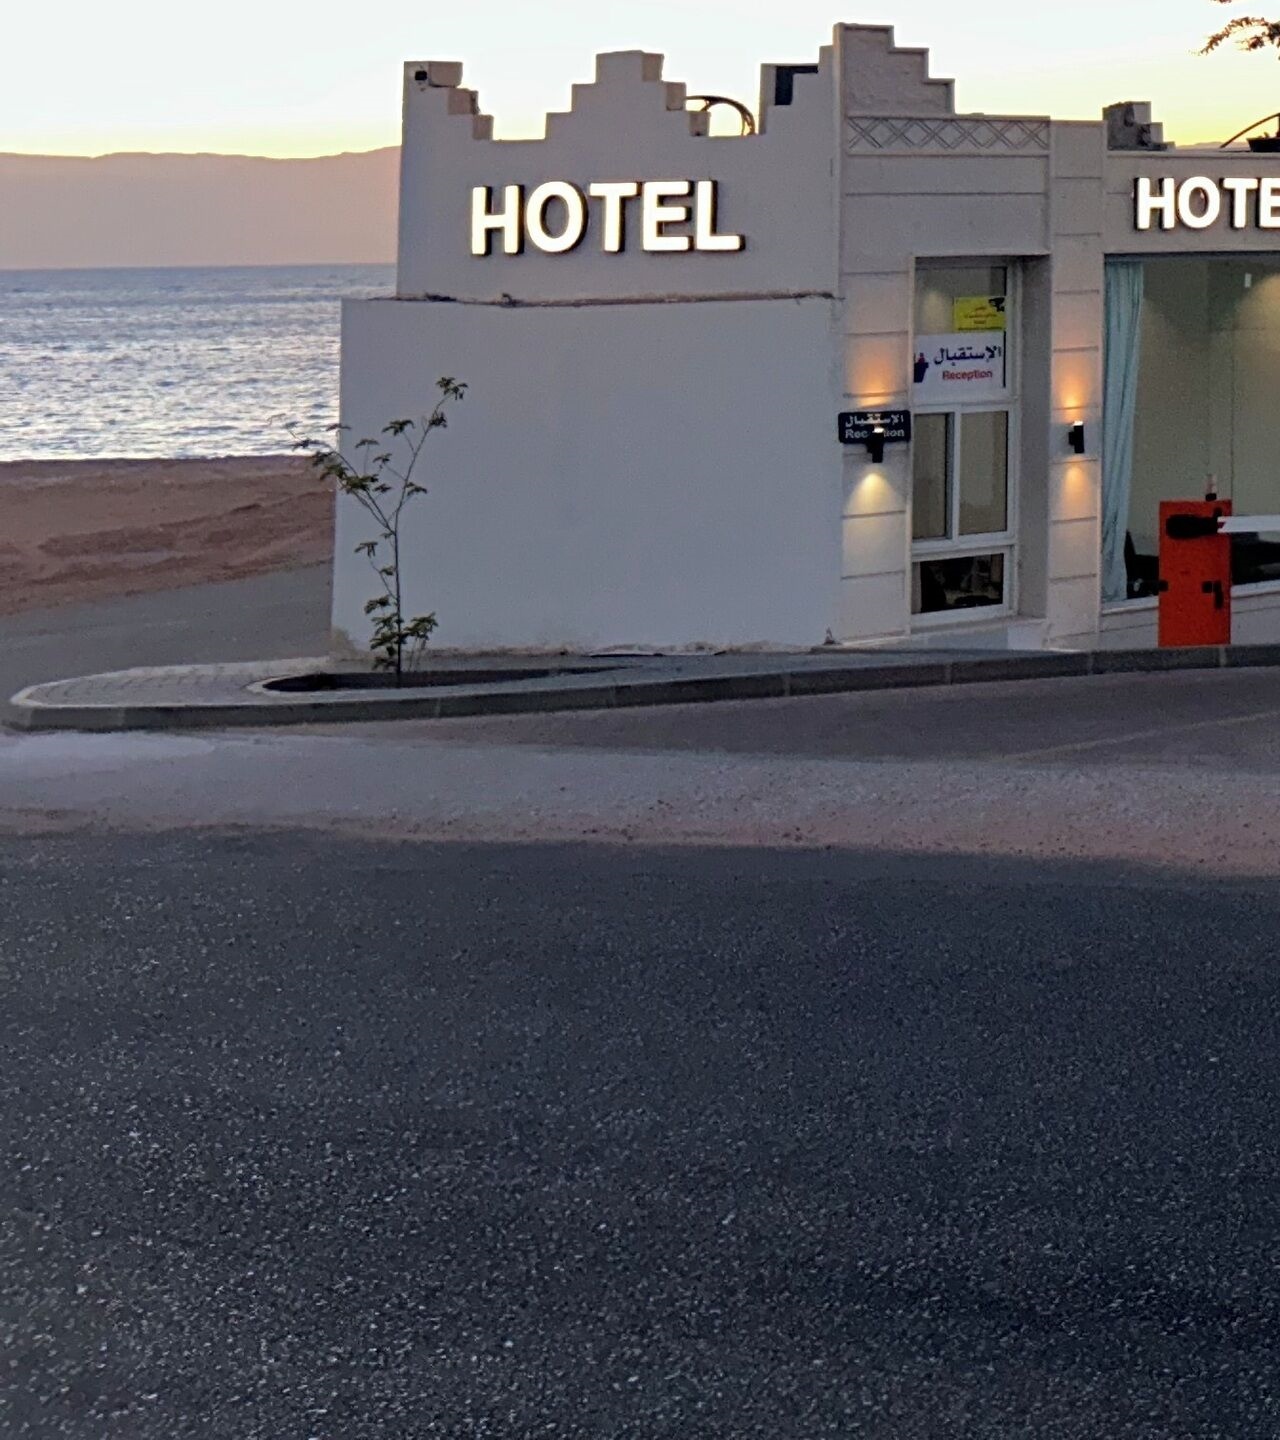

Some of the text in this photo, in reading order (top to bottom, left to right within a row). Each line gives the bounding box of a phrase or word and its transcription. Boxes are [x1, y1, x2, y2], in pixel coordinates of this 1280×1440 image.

[471, 179, 746, 256] HOTEL
[942, 369, 993, 381] Reception
[845, 428, 905, 439] Rection
